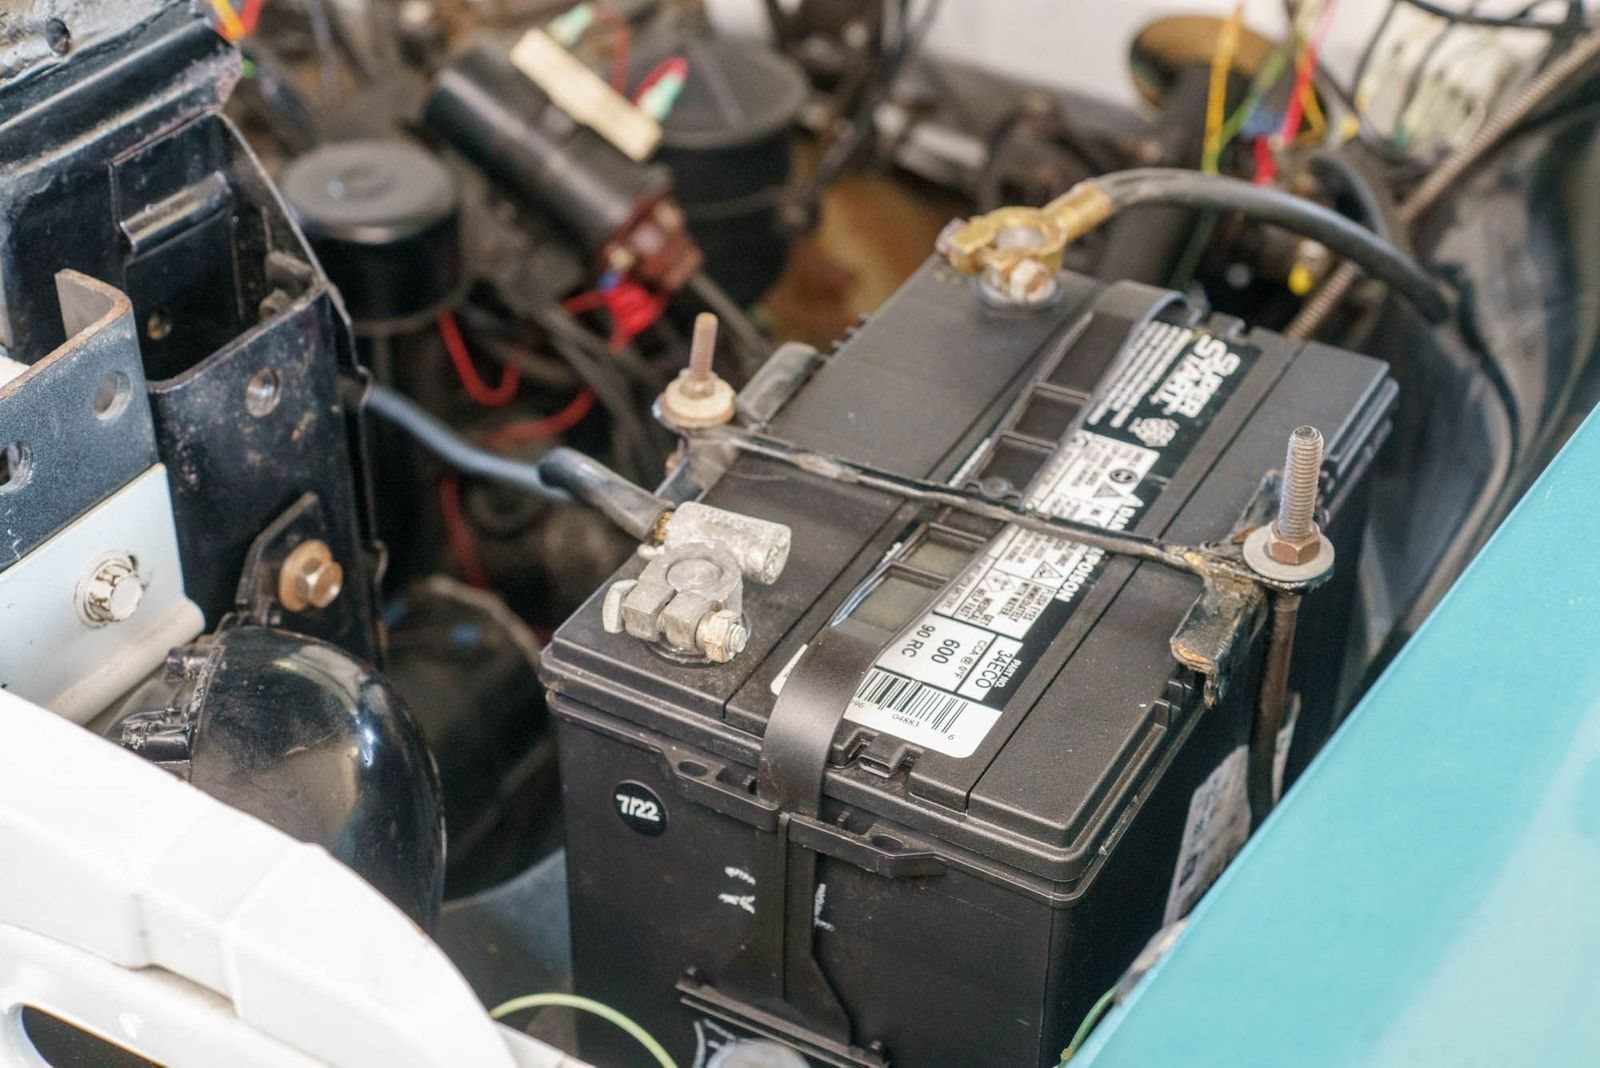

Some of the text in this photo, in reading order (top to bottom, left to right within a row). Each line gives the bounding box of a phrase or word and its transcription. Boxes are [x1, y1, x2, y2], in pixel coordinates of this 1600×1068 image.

[1157, 333, 1228, 411] START
[1010, 585, 1042, 622] IMMEDIATELY
[901, 624, 935, 658] 90 RC
[931, 639, 961, 664] 600
[971, 640, 987, 656] CCA
[960, 655, 974, 666] @
[975, 649, 1013, 689] 34ECO
[993, 658, 1022, 689] PART NO.
[891, 713, 920, 728] 04883
[615, 794, 661, 822] 7/22
